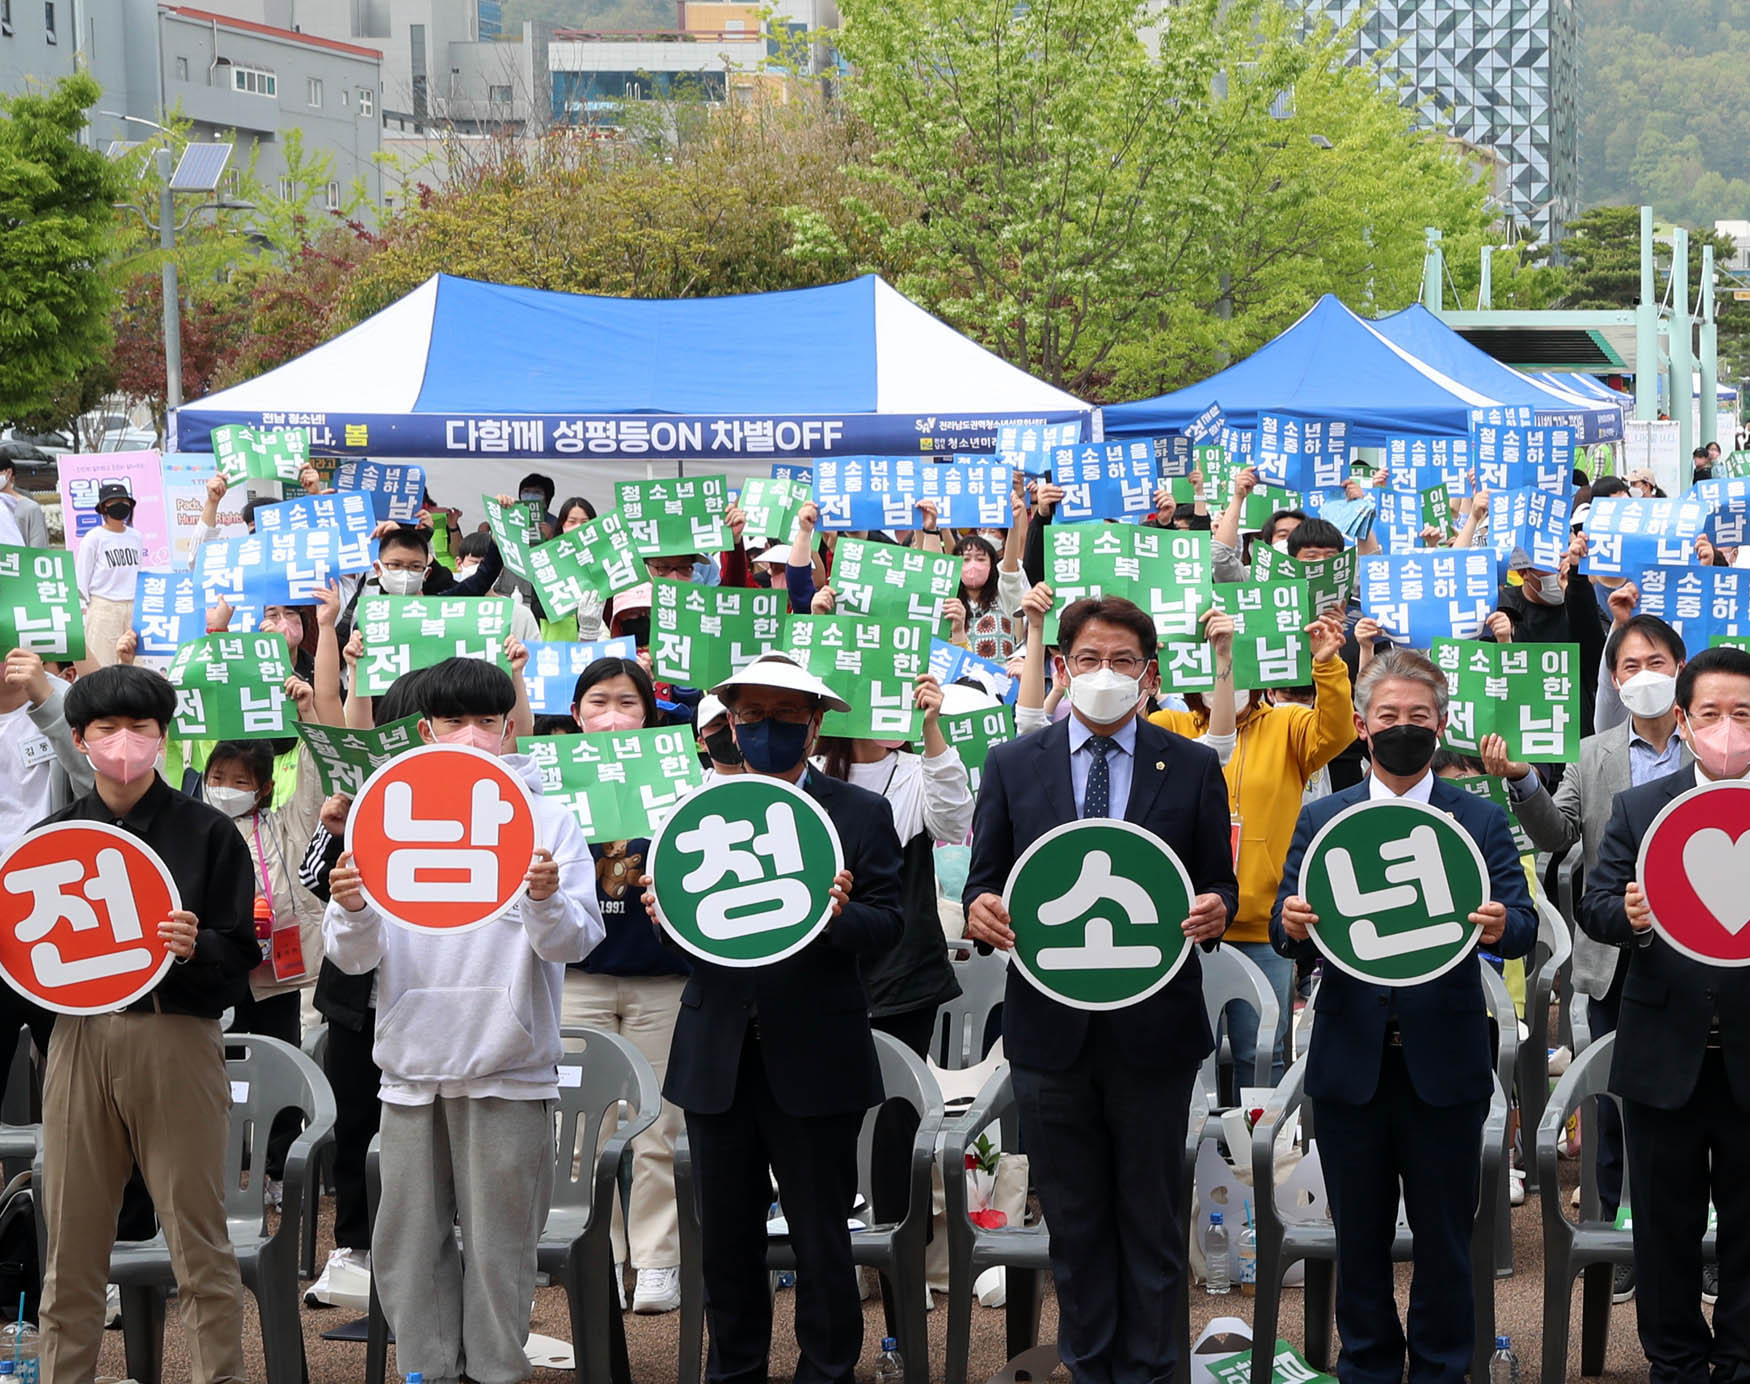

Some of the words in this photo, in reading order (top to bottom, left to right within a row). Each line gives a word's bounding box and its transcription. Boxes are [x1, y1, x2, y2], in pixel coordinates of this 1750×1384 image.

[445, 420, 543, 452] 다함께
[553, 420, 701, 453] 성평등ON
[710, 420, 843, 453] 차별OFF
[1262, 416, 1347, 437] 청소년을
[1480, 427, 1569, 447] 청소년을
[1056, 443, 1148, 466] 청소년을
[1261, 433, 1346, 454] 존중하는
[1391, 440, 1468, 454] 청소년을
[1479, 444, 1569, 463] 존중하는
[820, 461, 915, 477] 청소년을
[922, 465, 1007, 481] 청소년을
[1058, 460, 1150, 482] 존중하는
[1258, 451, 1344, 487] 전남
[1391, 453, 1468, 467] 존중하는
[621, 480, 721, 502] 청소년이
[819, 476, 915, 493] 존중하는
[922, 480, 1007, 495] 존중하는
[1061, 478, 1153, 517] 전남
[1391, 467, 1468, 498] 전남
[623, 497, 724, 519] 행복한
[820, 493, 917, 526] 전남
[627, 515, 725, 553] 전남
[1591, 516, 1699, 538] 존중하는
[842, 541, 955, 578] 청소년이
[1054, 530, 1200, 560] 청소년이
[839, 560, 954, 596] 행복한
[1054, 556, 1204, 584] 행복한
[1367, 555, 1488, 580] 청소년을
[657, 583, 777, 616] 청소년이
[1368, 577, 1490, 601] 존중하는
[366, 601, 506, 620] 청소년이
[657, 607, 779, 638] 행복한
[1370, 600, 1491, 643] 전남
[365, 617, 505, 643] 행복한
[792, 621, 919, 651] 청소년이
[175, 639, 280, 664] 청소년이
[1169, 635, 1302, 687] 전남
[1438, 644, 1569, 675] 청소년이
[172, 661, 285, 686] 행복한
[1442, 671, 1572, 701] 행복한
[174, 685, 286, 734] 전남
[1446, 701, 1570, 756] 전남
[528, 732, 684, 767] 청소년이
[537, 755, 691, 792] 행복한
[383, 778, 515, 902] 남
[673, 801, 805, 940] 청
[1325, 823, 1465, 960] 년
[4, 847, 152, 988] 전
[600, 901, 625, 914] 1991
[1036, 849, 1162, 969] 소
